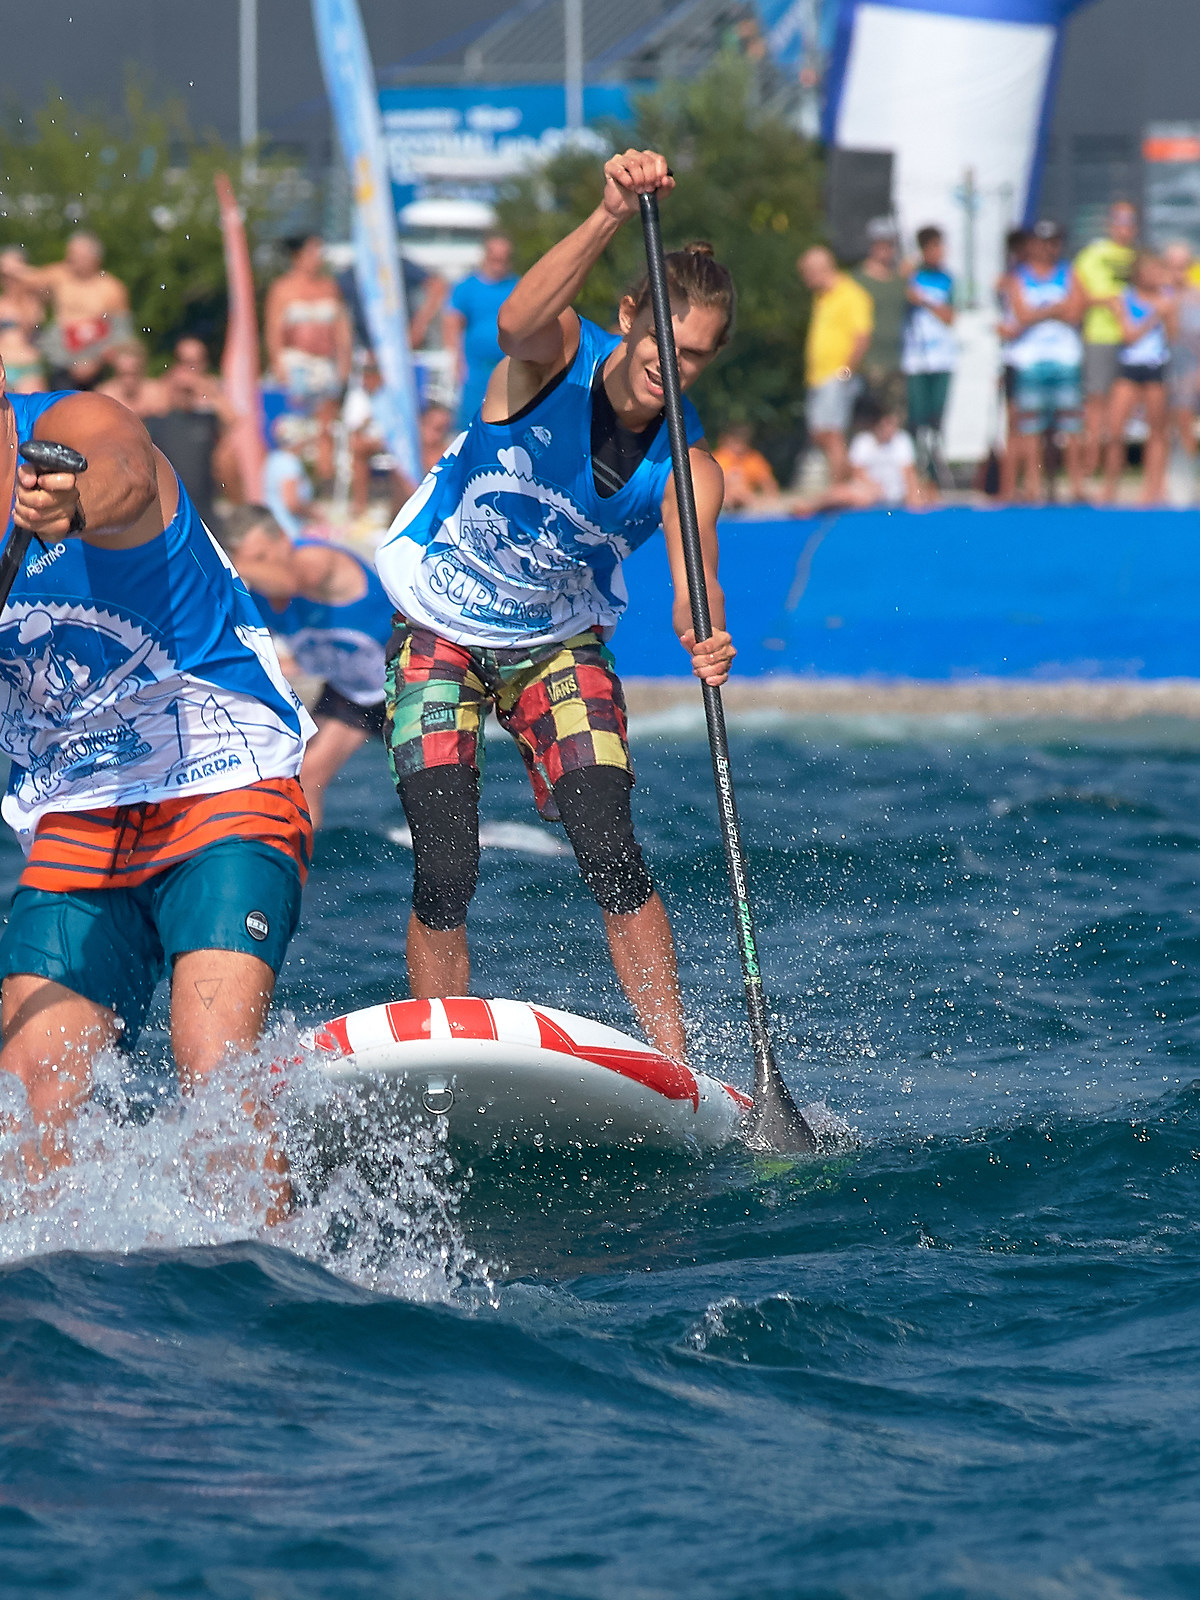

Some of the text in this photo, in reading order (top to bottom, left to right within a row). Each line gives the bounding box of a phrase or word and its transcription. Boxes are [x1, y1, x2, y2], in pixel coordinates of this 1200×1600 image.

[429, 560, 493, 616] SUP
[547, 674, 578, 702] VANS
[175, 754, 242, 785] GARDA
[716, 752, 747, 899] REACTIVE FLEX TECHNOLOGY
